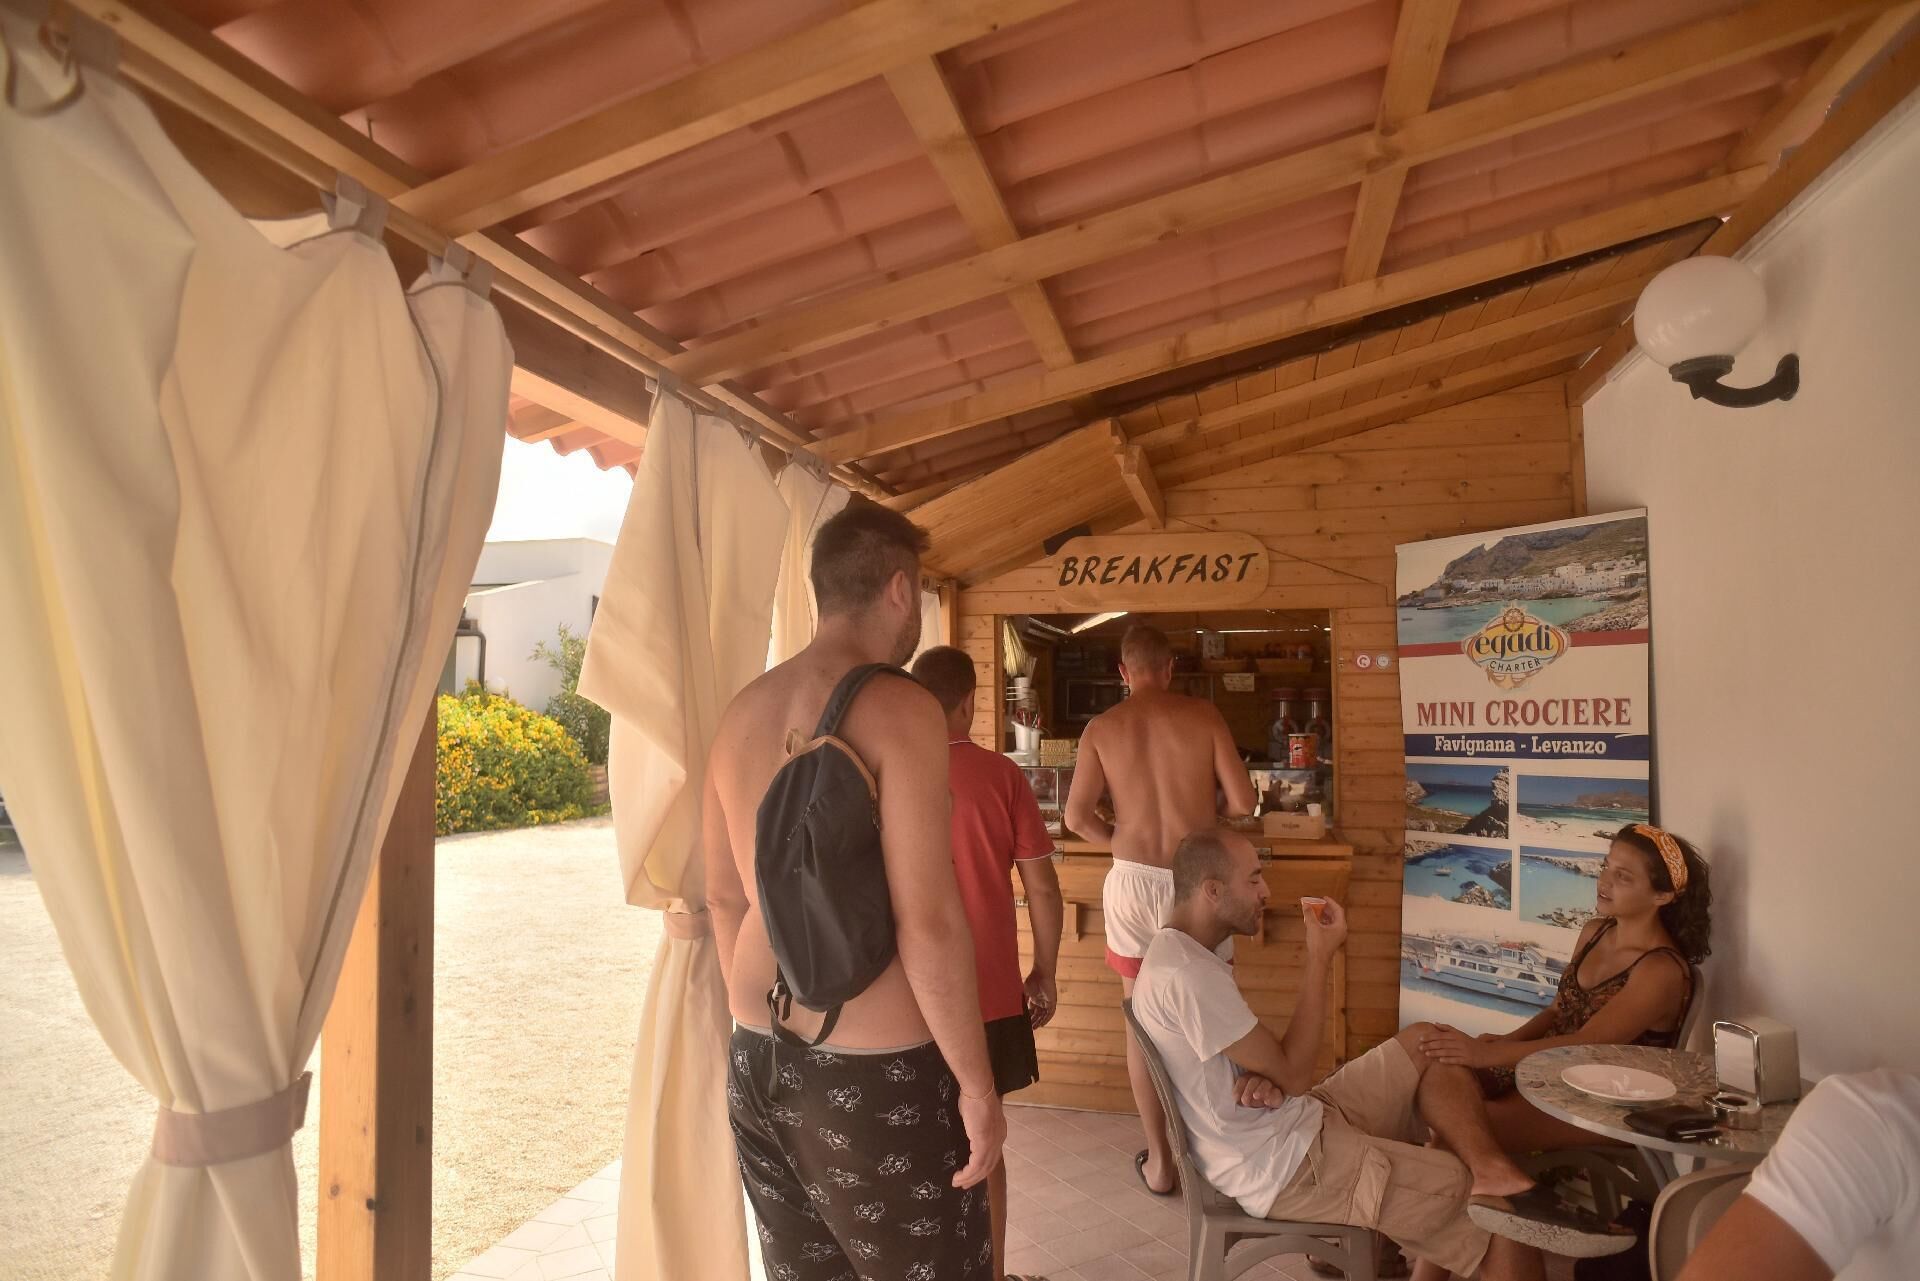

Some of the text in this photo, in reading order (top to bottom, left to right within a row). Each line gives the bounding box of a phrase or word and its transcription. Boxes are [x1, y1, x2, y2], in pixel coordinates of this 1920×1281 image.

[1058, 552, 1259, 586] BREAKFAST
[1475, 624, 1553, 659] egadi
[1489, 658, 1541, 672] CHARTER
[1417, 698, 1632, 727] MINI CROCIERE
[1434, 735, 1516, 755] Favignana
[1531, 735, 1607, 755] Levanzo
